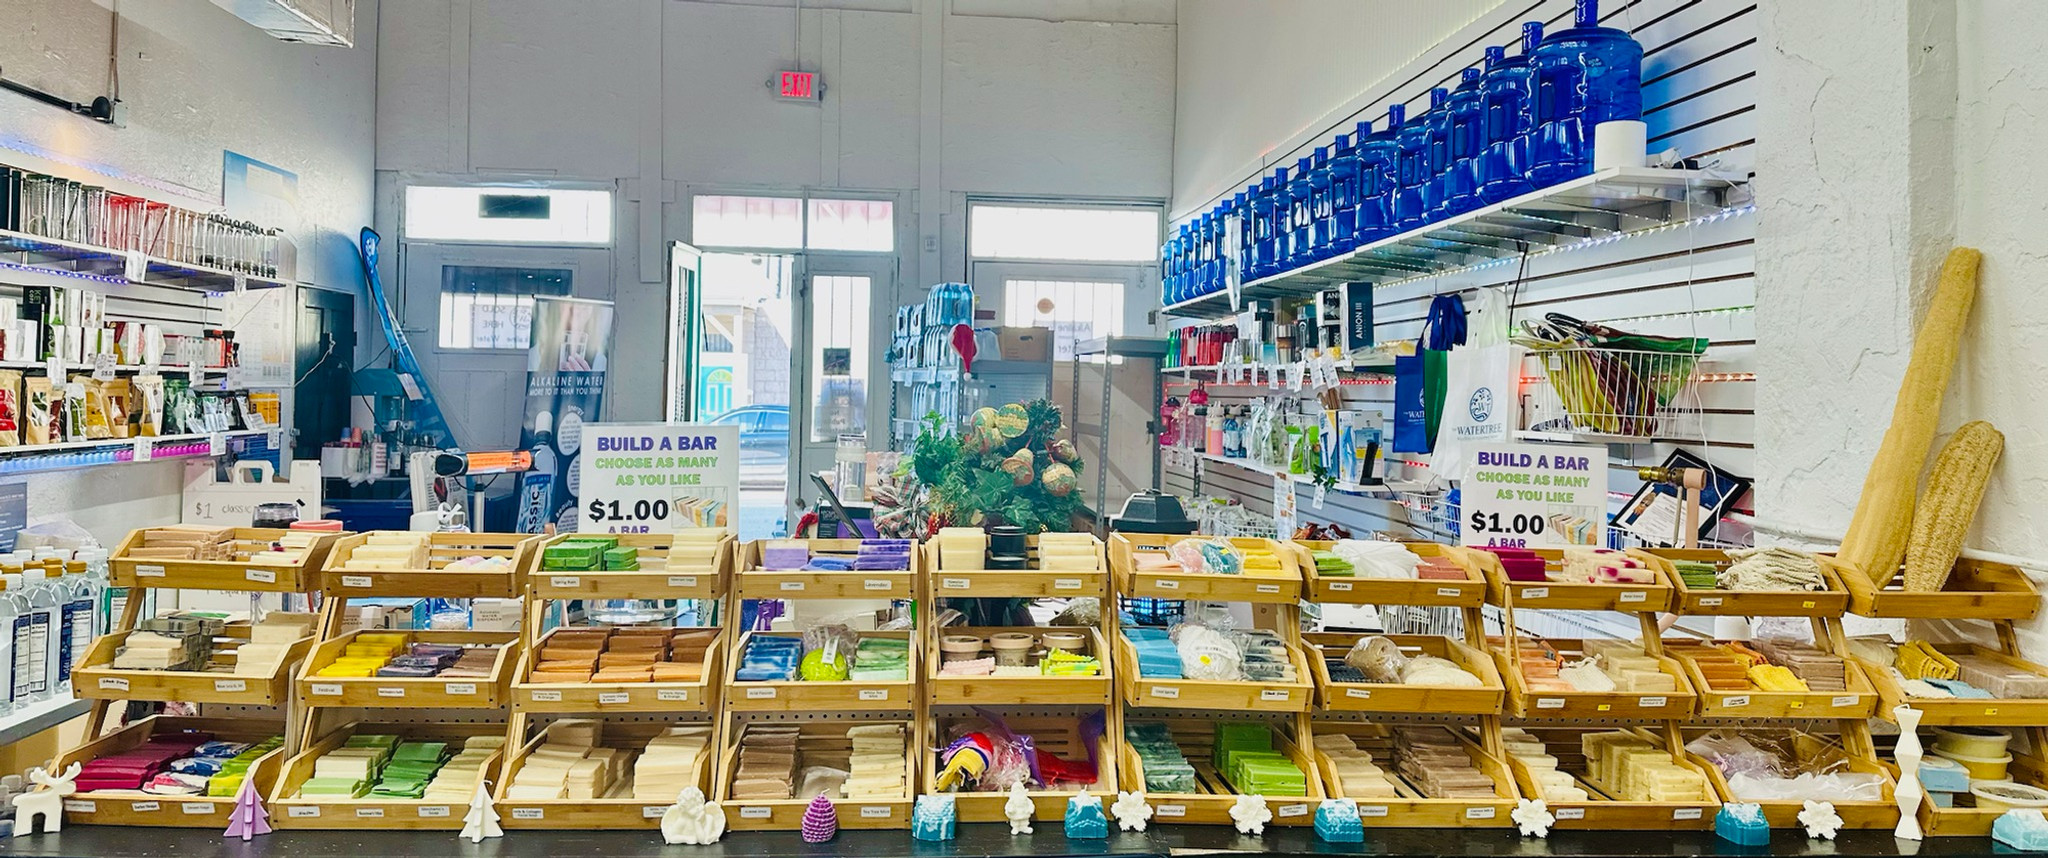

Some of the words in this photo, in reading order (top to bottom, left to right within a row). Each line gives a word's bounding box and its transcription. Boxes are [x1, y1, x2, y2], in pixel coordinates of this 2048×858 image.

[781, 72, 814, 97] EXIT
[1355, 312, 1363, 339] ANION
[530, 377, 571, 387] ALKALINE
[529, 388, 543, 396] MORE
[545, 388, 552, 396] TO
[568, 405, 584, 416] Energy
[1457, 423, 1503, 436] WATERTREE
[598, 437, 654, 451] BUILD
[659, 437, 672, 450] A
[678, 436, 717, 450] BAR
[595, 457, 652, 468] CHOOSE
[656, 457, 674, 468] AS
[678, 456, 718, 467] MANY
[1478, 452, 1531, 467] BUILD
[1537, 455, 1549, 469] A
[1554, 456, 1589, 471] BAR
[616, 475, 634, 486] AS
[638, 475, 666, 486] YOU
[670, 474, 701, 485] LIKE
[1476, 472, 1530, 485] CHOOSE
[1534, 474, 1550, 486] AS
[1553, 476, 1590, 488] MANY
[1496, 489, 1513, 500] AS
[1517, 490, 1542, 501] YOU
[1546, 492, 1574, 503] LIKE
[196, 502, 213, 519] $1
[222, 503, 252, 514] classic
[528, 491, 540, 533] ASSIC
[589, 499, 668, 522] $1.00
[1471, 510, 1544, 535] $1.00
[1488, 538, 1498, 547] A
[1501, 538, 1526, 548] BAR
